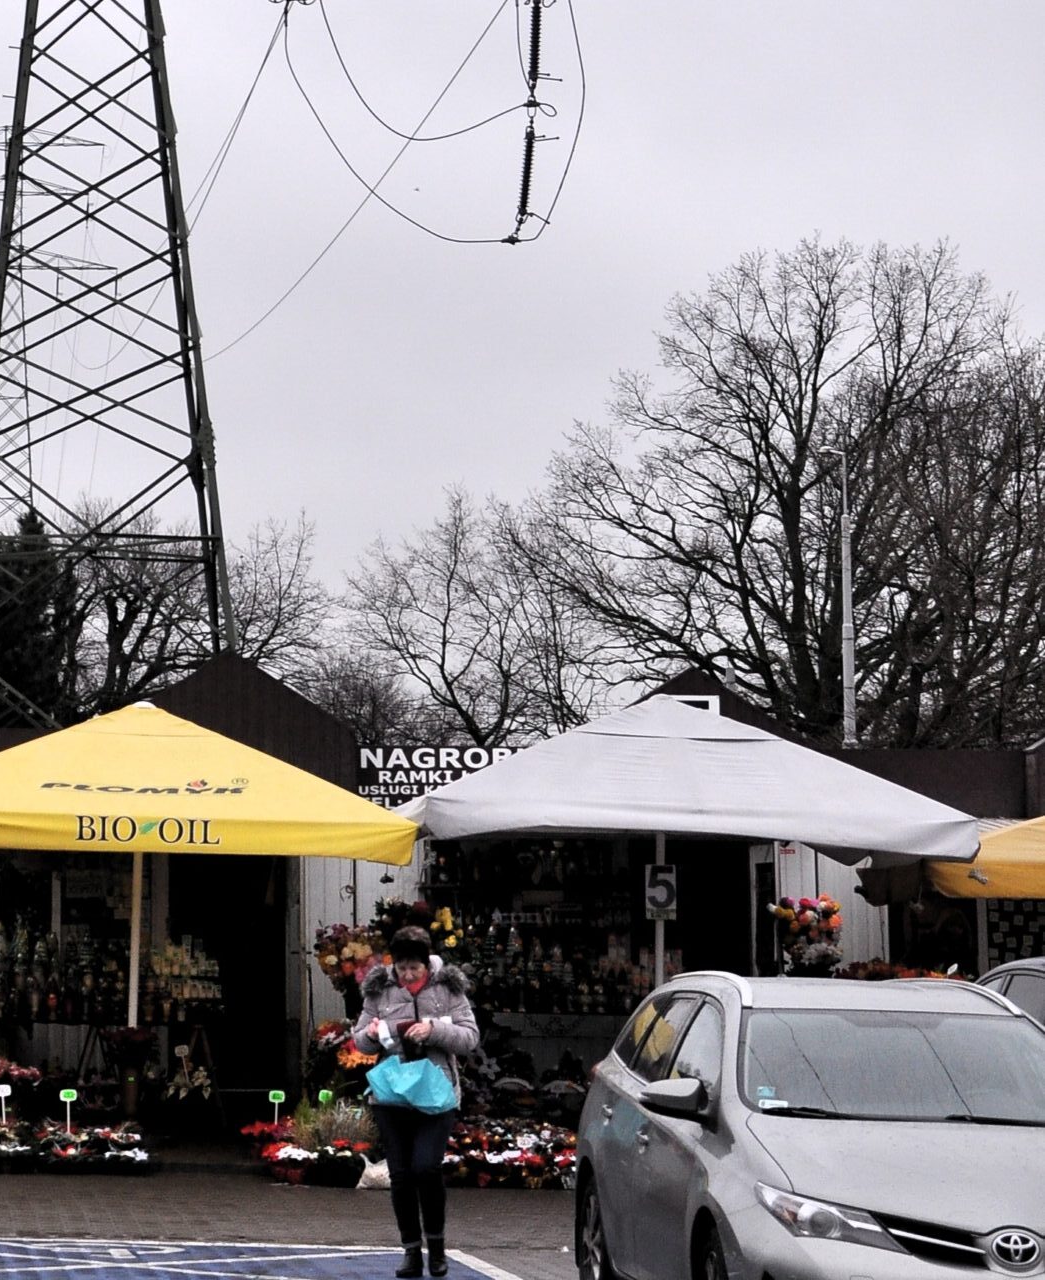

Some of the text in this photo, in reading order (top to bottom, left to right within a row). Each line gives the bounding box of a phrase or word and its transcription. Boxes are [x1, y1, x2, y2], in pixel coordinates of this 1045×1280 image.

[360, 747, 527, 769] NAGROB
[378, 770, 453, 784] RAMKI
[358, 785, 419, 796] USŁUGI
[75, 815, 221, 845] BIO OIL
[647, 865, 675, 908] 5
